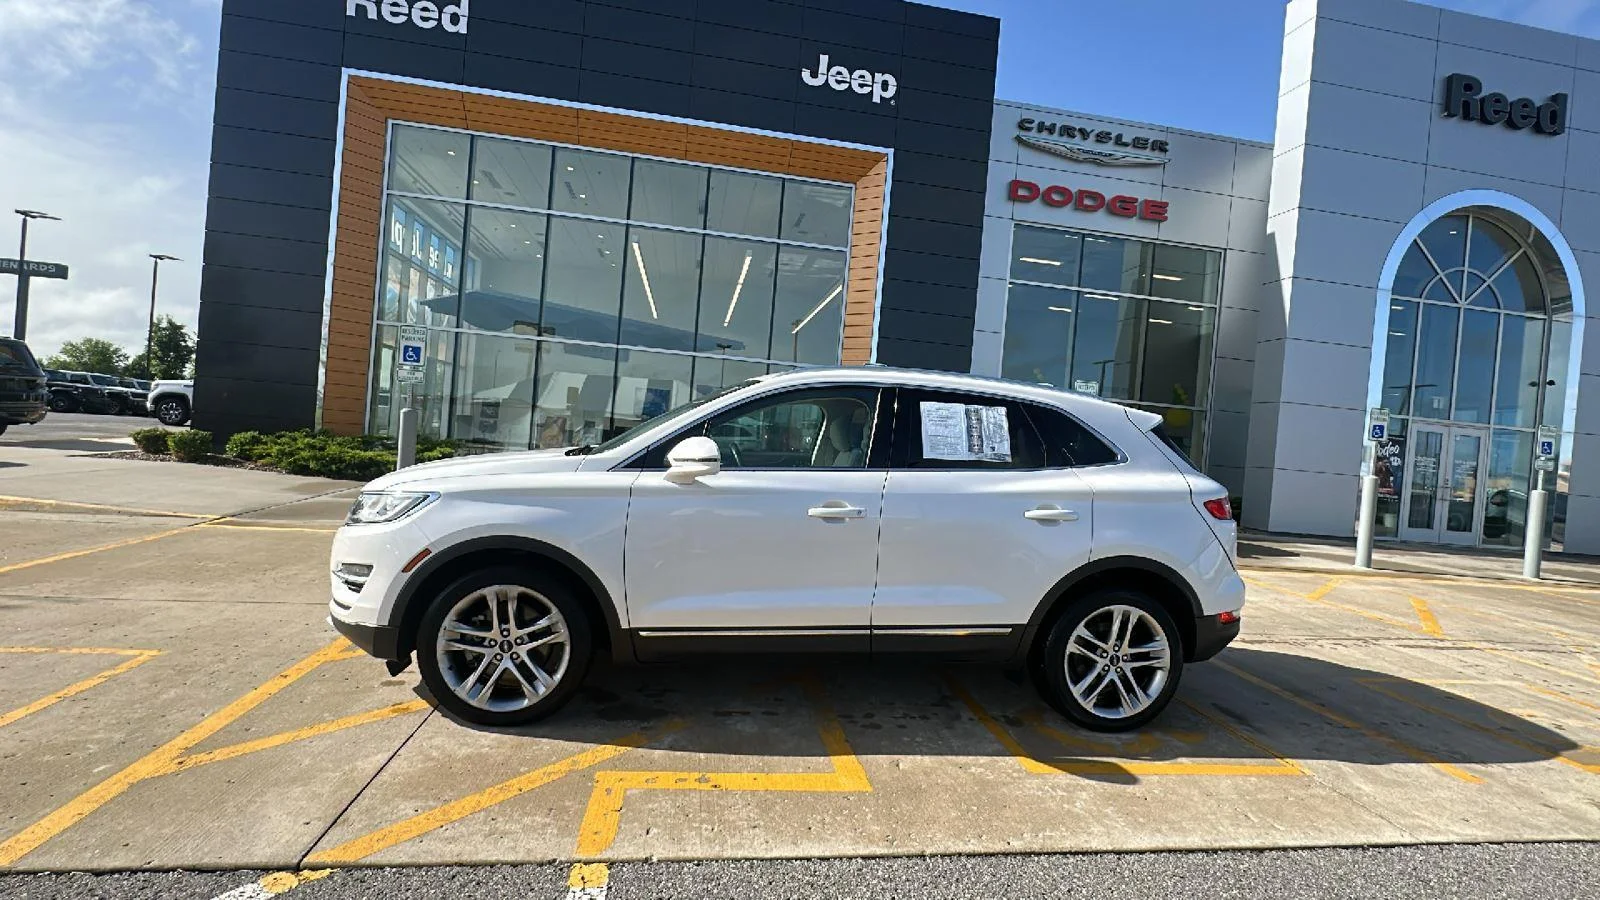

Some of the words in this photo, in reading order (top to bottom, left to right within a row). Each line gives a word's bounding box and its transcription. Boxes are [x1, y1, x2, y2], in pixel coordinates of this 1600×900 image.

[801, 54, 898, 104] Jeep
[1443, 73, 1568, 136] Reed
[1018, 117, 1169, 152] CHRYSLER
[1009, 179, 1169, 222] DODGE
[0, 260, 56, 272] ENRDS
